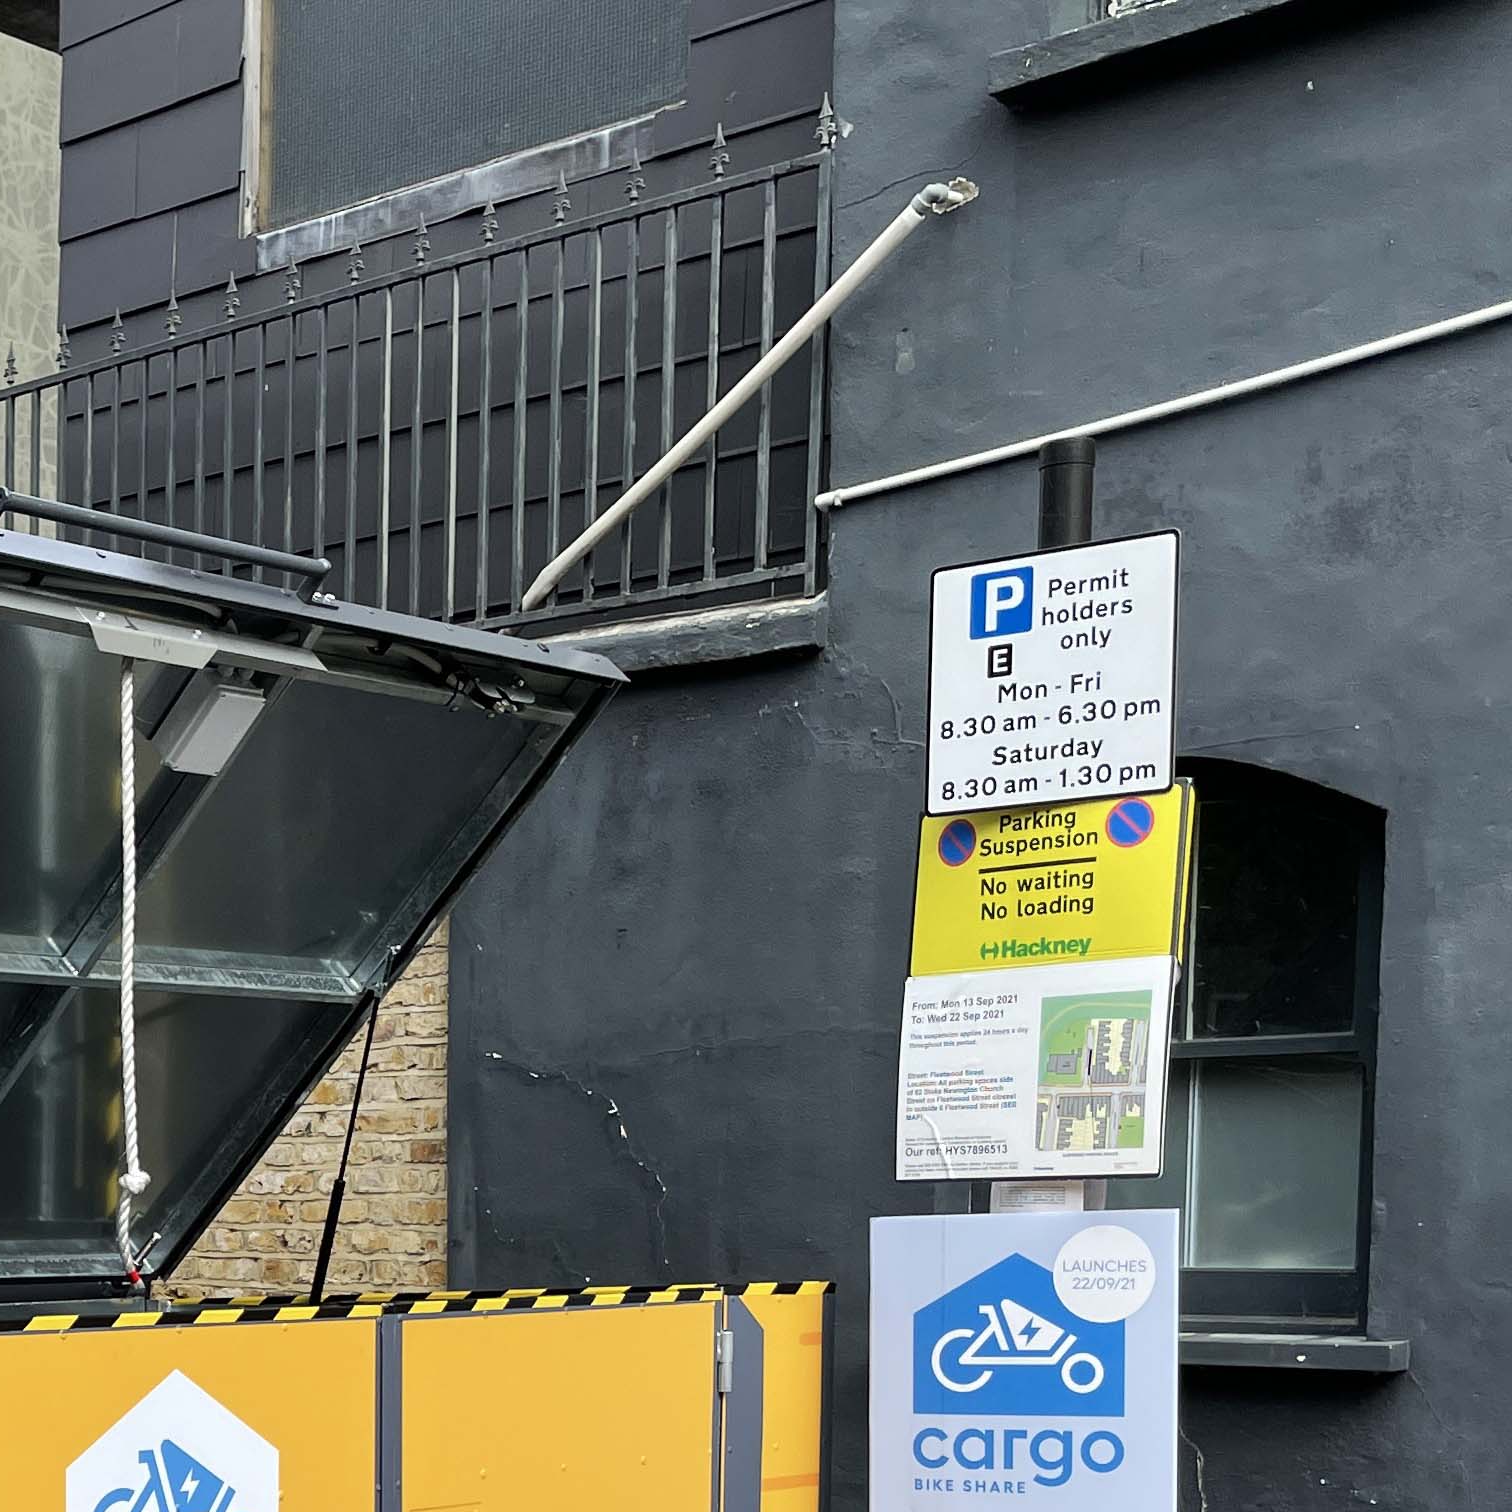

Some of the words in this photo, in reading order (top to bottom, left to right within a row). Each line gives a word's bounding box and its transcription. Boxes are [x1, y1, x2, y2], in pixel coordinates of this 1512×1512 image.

[1048, 568, 1129, 598] Permit
[985, 575, 1024, 632] P
[1042, 599, 1133, 626] holders
[1060, 626, 1112, 650] only
[992, 648, 1008, 674] E
[998, 682, 1047, 703] Mon
[1070, 671, 1102, 694] Fri
[940, 715, 996, 740] 8.30
[1003, 713, 1036, 732] am
[1058, 700, 1116, 725] 6.30
[1124, 698, 1161, 720] pm
[992, 737, 1103, 766] Saturday
[942, 776, 997, 801] 8.30
[1004, 775, 1038, 794] am
[1059, 763, 1112, 788] 1.30
[1119, 762, 1156, 785] pm
[999, 811, 1076, 833] Parking
[979, 828, 1098, 857] Suspension
[980, 878, 1007, 896] No
[1017, 870, 1094, 892] waiting
[981, 902, 1007, 920] No
[1017, 895, 1094, 917] loading
[1002, 937, 1092, 958] Hackney
[912, 1001, 938, 1010] From:
[941, 1000, 960, 1009] Mon
[964, 998, 973, 1006] 13
[976, 997, 994, 1006] Sep
[997, 994, 1018, 1004] 2021
[912, 1015, 924, 1024] To:
[928, 1013, 946, 1023] Wed
[950, 1013, 960, 1022] 22
[963, 1011, 981, 1022] Sep
[983, 1010, 1005, 1019] 2021
[905, 1147, 922, 1156] Our
[1063, 1260, 1146, 1273] LAUNCHES
[1072, 1277, 1136, 1290] 22/09/21
[913, 1427, 1124, 1487] cargo
[914, 1478, 954, 1491] BIKE
[963, 1480, 1026, 1494] SHARE
